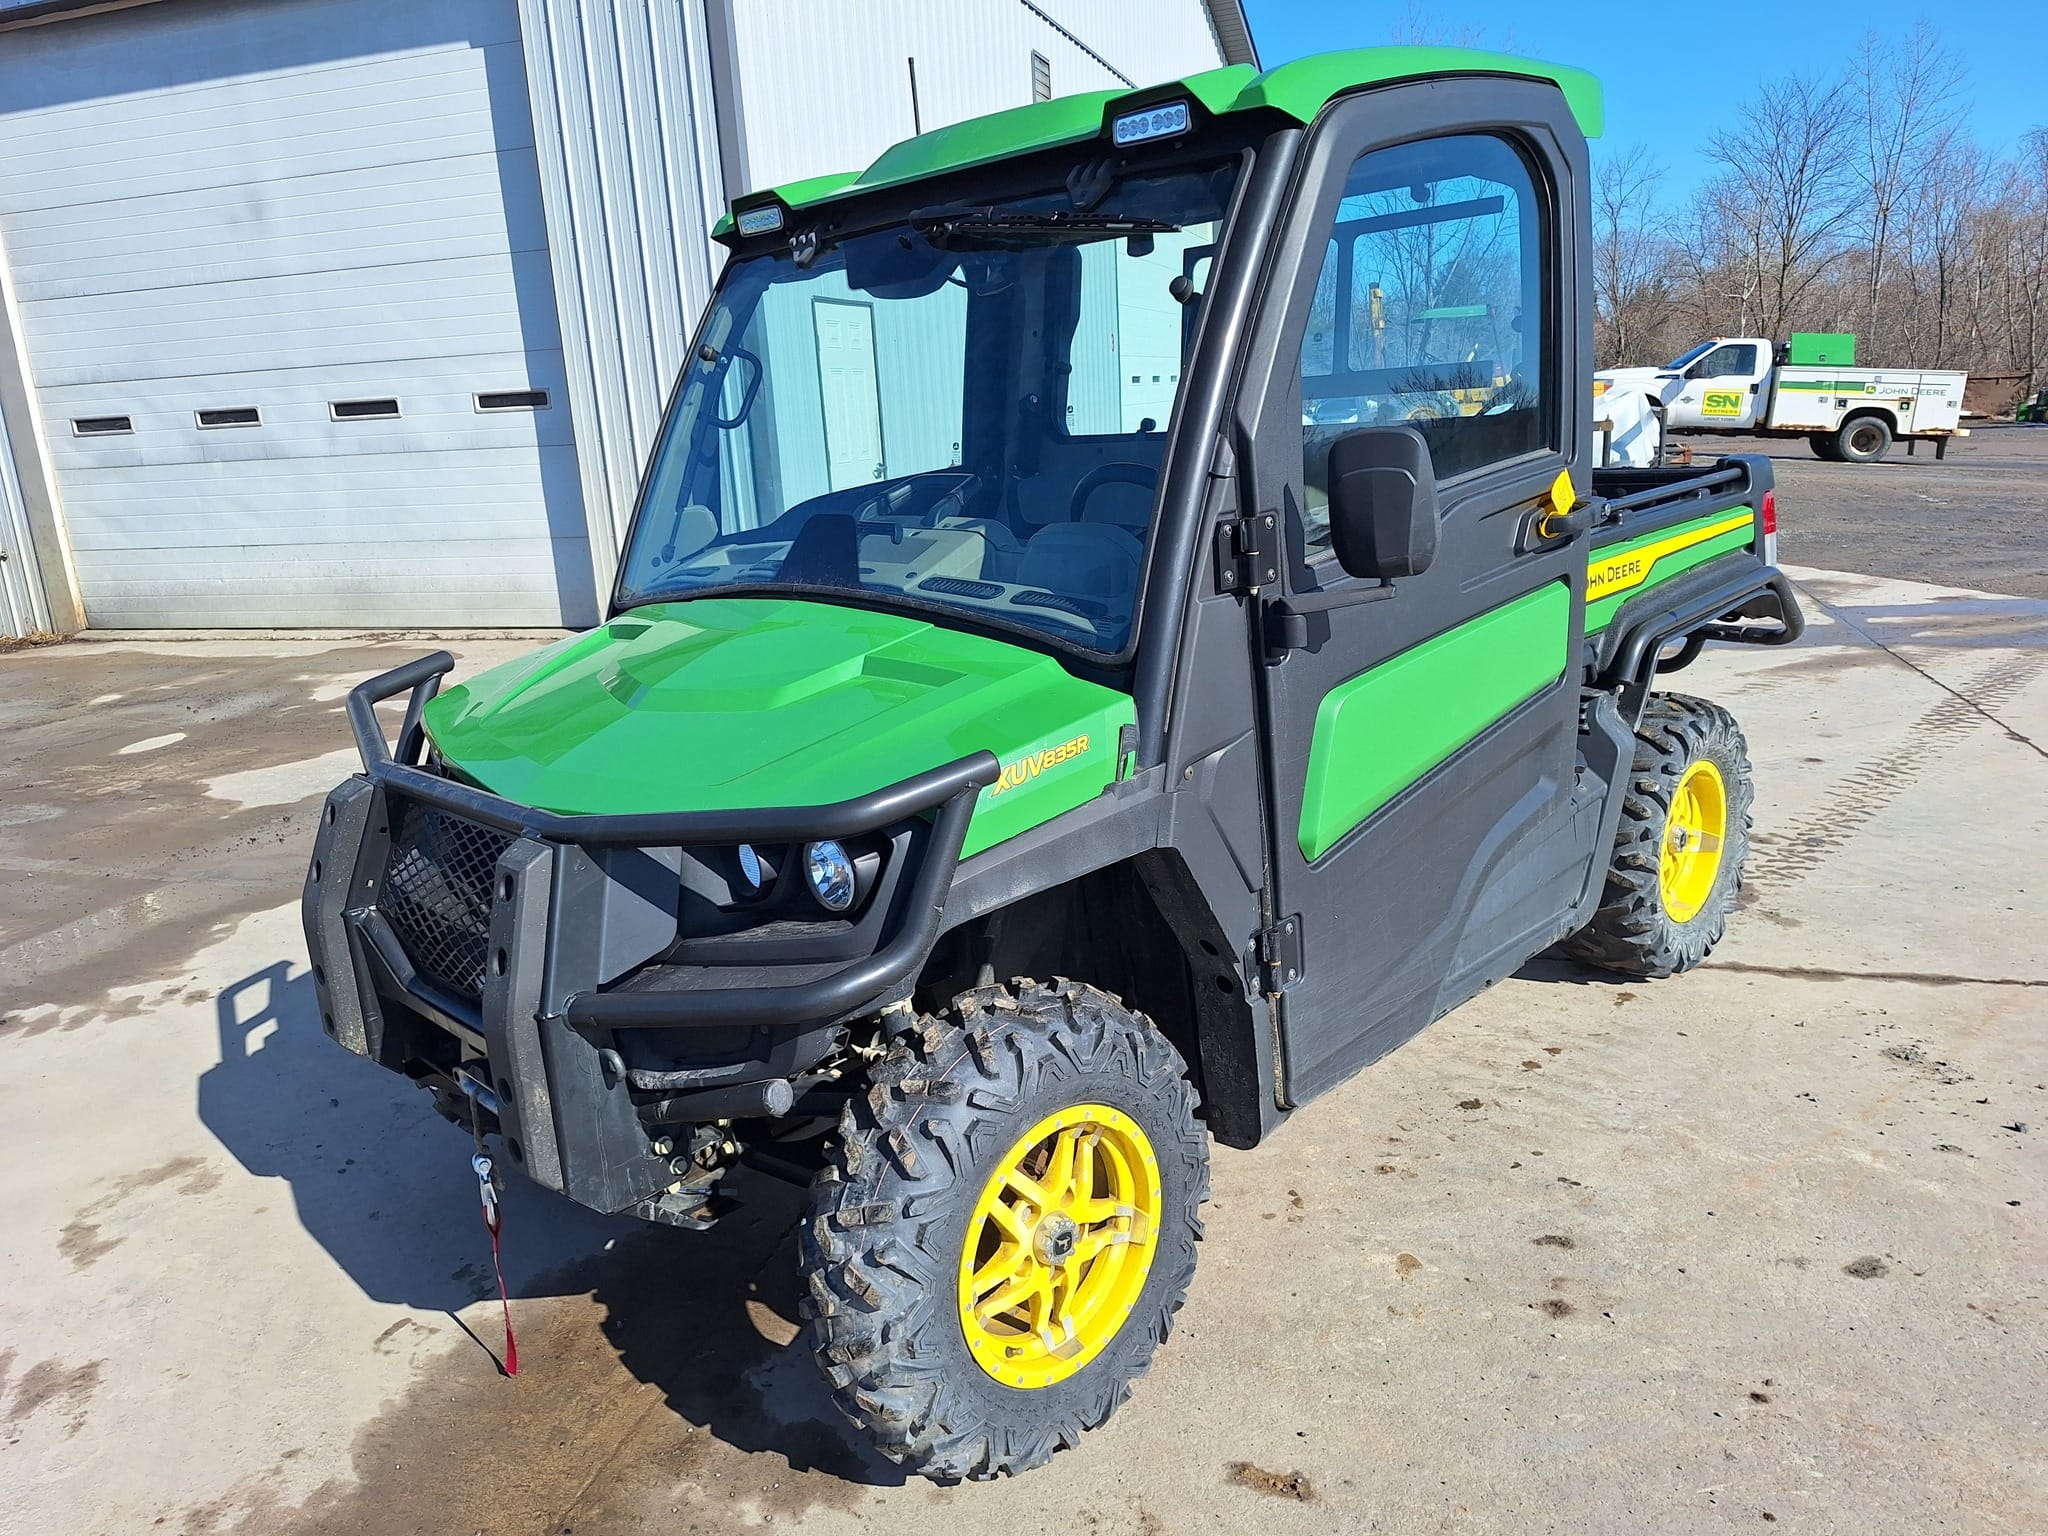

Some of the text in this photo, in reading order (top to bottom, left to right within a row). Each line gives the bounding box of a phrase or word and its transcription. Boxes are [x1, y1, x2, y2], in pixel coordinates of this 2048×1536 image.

[1878, 386, 1947, 397] JOHN DEERE
[1588, 559, 1641, 590] HN DEERE
[990, 735, 1089, 798] XUV835R
